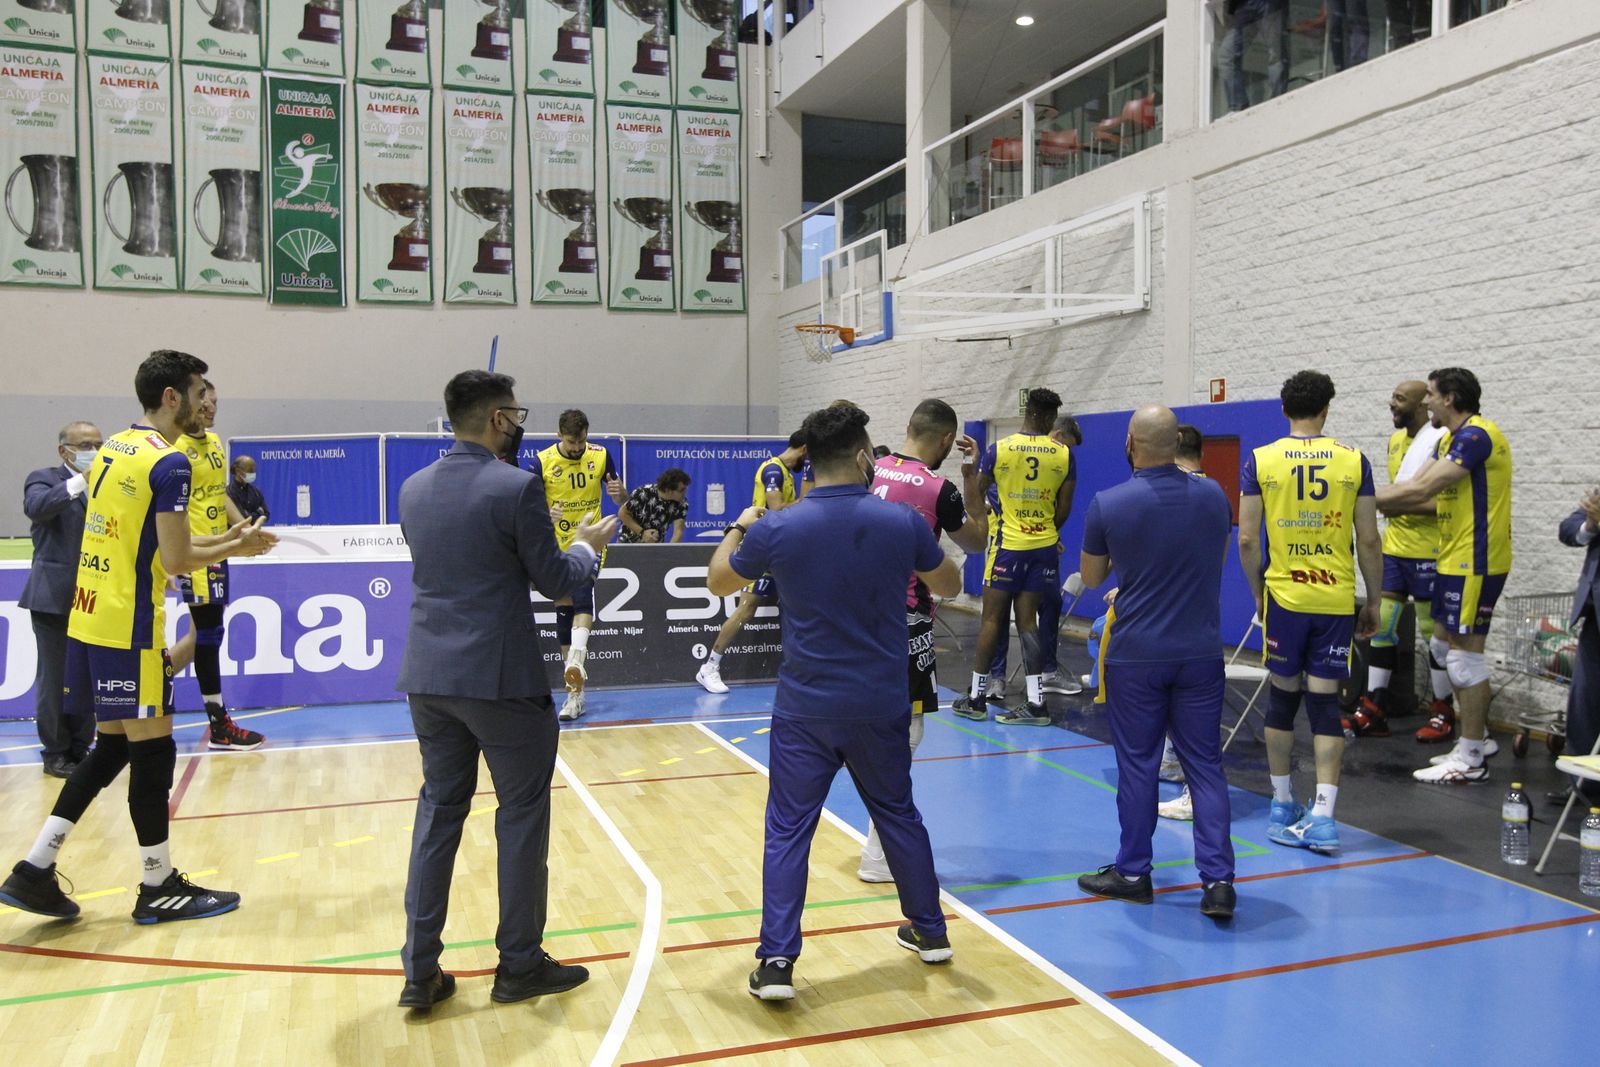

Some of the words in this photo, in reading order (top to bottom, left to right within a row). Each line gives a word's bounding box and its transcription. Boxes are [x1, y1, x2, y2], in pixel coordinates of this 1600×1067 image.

[28, 28, 60, 38] Unicaja
[126, 38, 155, 48] Unicaja
[219, 48, 247, 59] Unicaja
[4, 54, 60, 67] UNICAJA
[303, 58, 330, 67] Unicaja
[1, 67, 64, 81] ALMERÍA
[103, 64, 156, 77] UNICAJA
[391, 67, 416, 76] Unicaja
[100, 77, 159, 90] ALMERÍA
[197, 73, 247, 85] UNICAJA
[475, 74, 500, 83] Unicaja
[558, 78, 581, 86] Unicaja
[194, 85, 250, 98] ALMERÍA
[637, 90, 660, 98] Unicaja
[278, 90, 332, 104] UNICAJA
[370, 92, 416, 103] UNICAJA
[706, 94, 728, 102] Unicaja
[456, 97, 501, 108] UNICAJA
[539, 102, 582, 111] UNICAJA
[276, 104, 336, 119] ALMERÍA
[366, 104, 420, 115] ALMERÍA
[453, 109, 503, 120] ALMERÍA
[537, 112, 584, 123] ALMERÍA
[618, 112, 660, 121] UNICAJA
[688, 116, 728, 126] UNICAJA
[616, 123, 663, 133] ALMERÍA
[686, 128, 731, 137] ALMERÍA
[36, 268, 67, 277] Unicaja
[134, 273, 162, 282] Unicaja
[221, 278, 248, 287] Unicaja
[282, 272, 333, 288] Unicaja
[393, 286, 418, 296] Unicaja
[477, 288, 502, 298] Unicaja
[564, 288, 587, 296] Unicaja
[640, 295, 662, 303] Unicaja
[711, 296, 732, 304] Unicaja
[262, 450, 302, 460] DIPUTACIÓN
[305, 450, 314, 459] DE
[314, 447, 345, 458] ALMERÍA
[656, 448, 715, 458] DIPUTACIÓN
[718, 450, 729, 458] DE
[732, 448, 772, 459] ALMERÍA
[1009, 446, 1056, 454] C.FURTADO
[1285, 451, 1333, 459] NASSINI
[205, 452, 222, 470] 16
[1025, 456, 1039, 481] 3
[92, 456, 114, 498] 7
[569, 472, 586, 489] 10
[1291, 465, 1328, 500] 15
[1298, 510, 1322, 518] Islas
[685, 520, 716, 528] UTACIÓN
[1277, 519, 1322, 528] Canarias
[343, 536, 393, 546] FÁBRICA
[1288, 544, 1333, 556] 7ISLAS
[758, 579, 769, 591] 17
[213, 583, 224, 598] 16
[624, 627, 644, 636] Níjar
[668, 625, 698, 633] Almería
[744, 622, 780, 630] Roquetas
[1329, 645, 1350, 656] HPS
[98, 680, 136, 691] HPS
